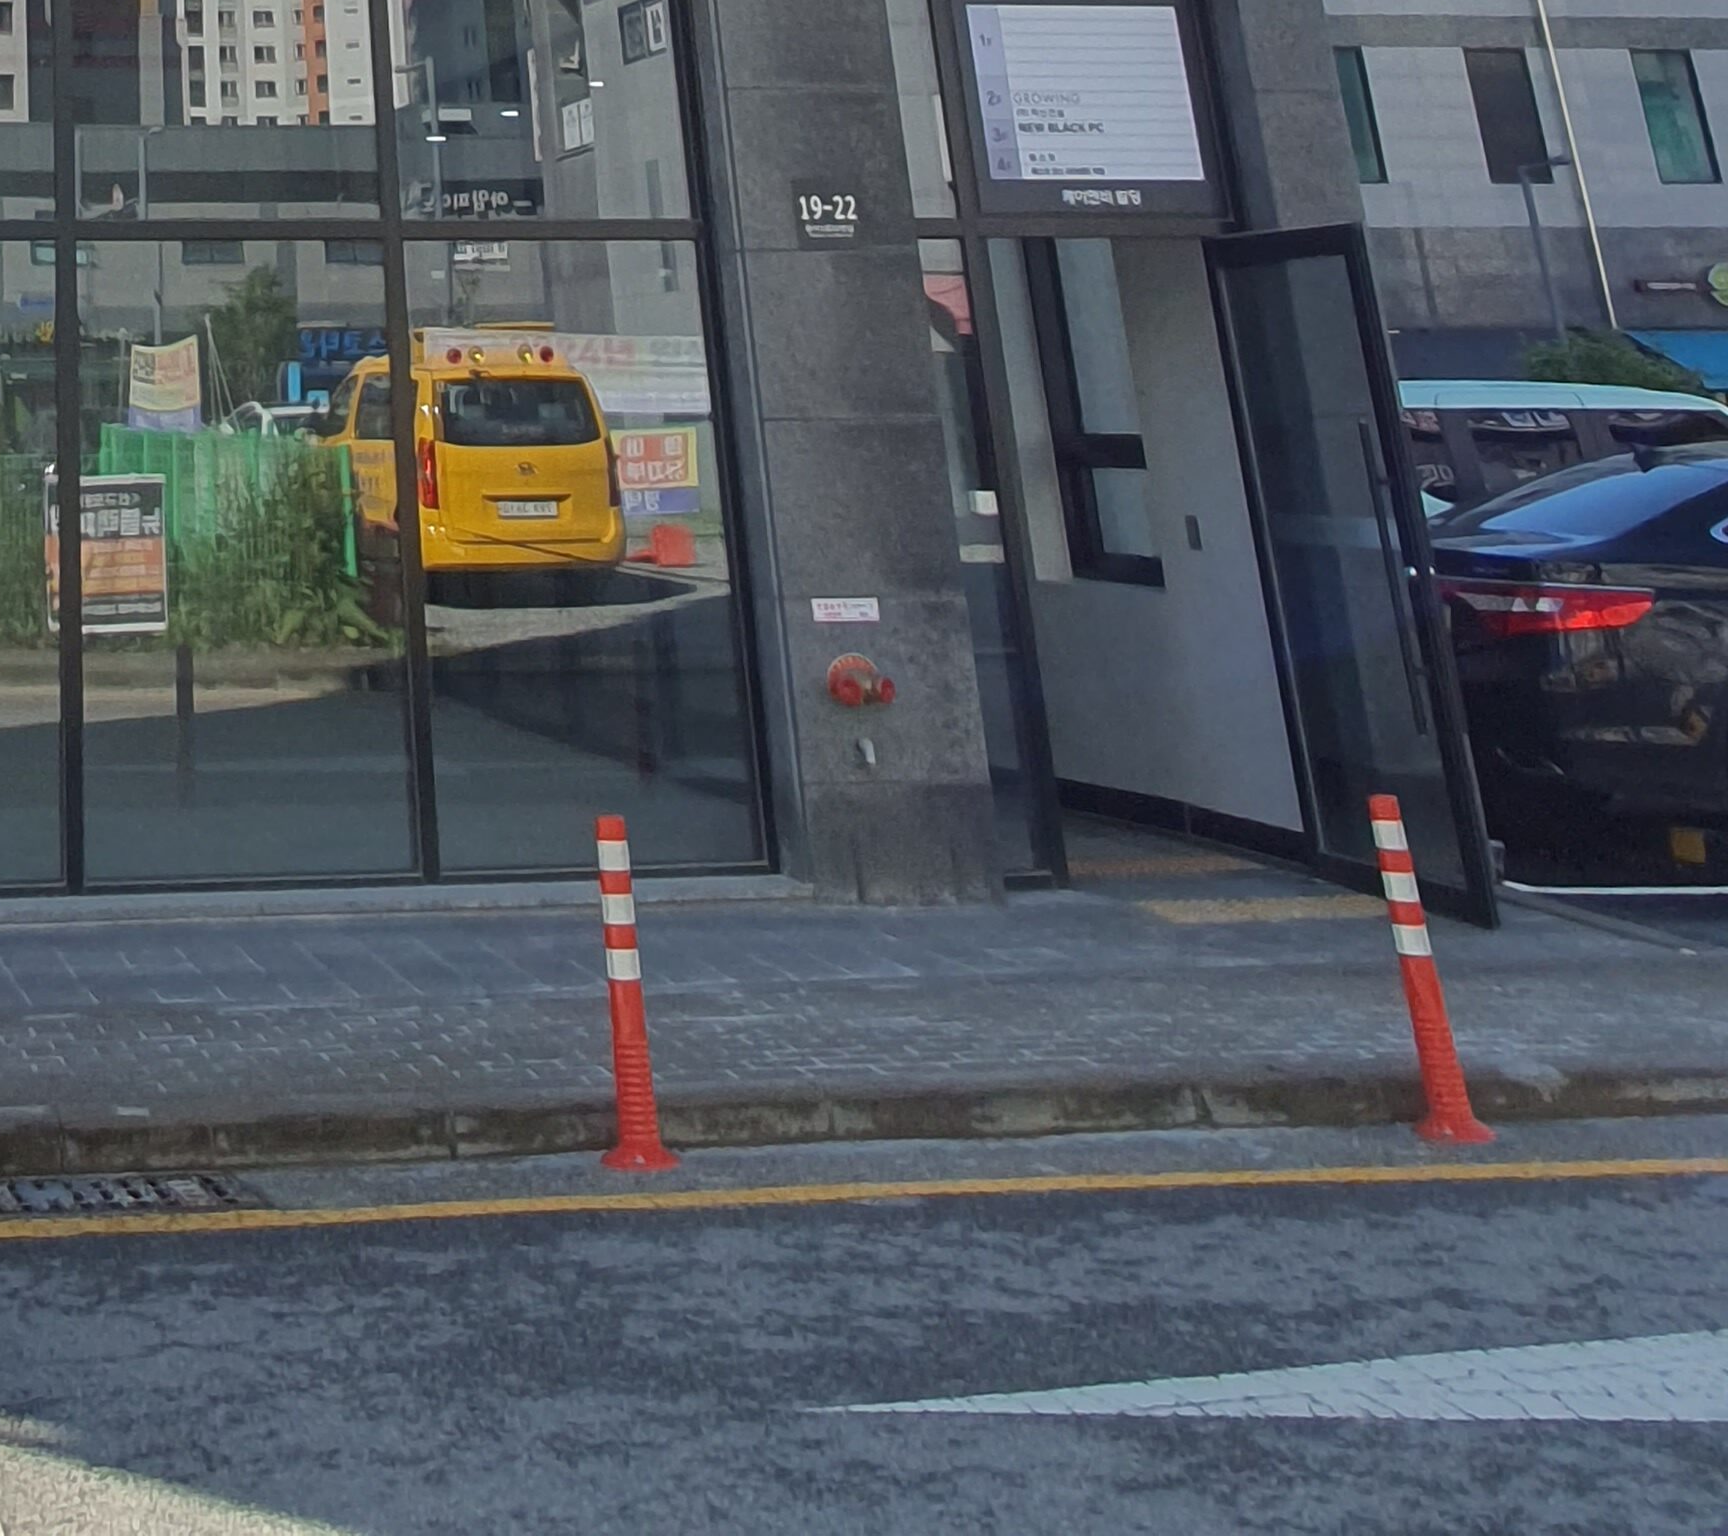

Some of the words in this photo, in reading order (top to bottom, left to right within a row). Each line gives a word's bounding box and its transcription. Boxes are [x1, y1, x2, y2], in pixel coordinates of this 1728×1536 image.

[1013, 92, 1081, 106] GROWING
[1048, 122, 1087, 134] BLACK
[1088, 122, 1105, 133] PC
[799, 194, 858, 221] 19-22
